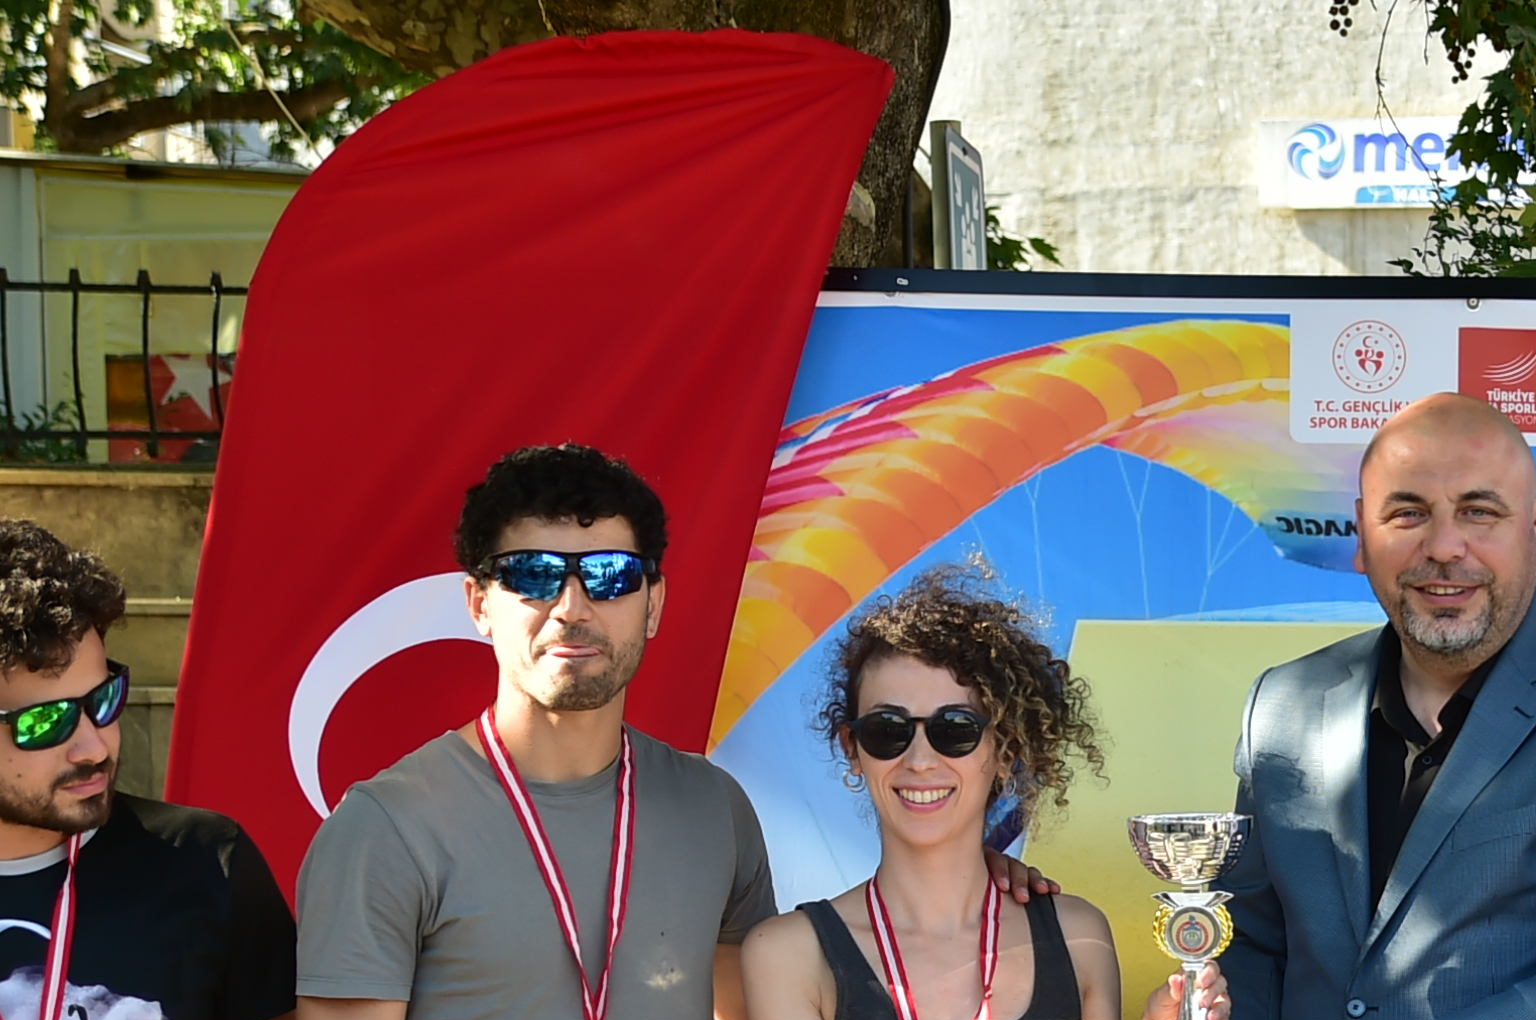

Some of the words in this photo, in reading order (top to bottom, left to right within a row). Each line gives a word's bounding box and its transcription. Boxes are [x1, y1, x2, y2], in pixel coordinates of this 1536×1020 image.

[1486, 388, 1535, 402] TÜRKİYE
[1314, 401, 1338, 412] T.C.
[1310, 417, 1347, 429] SPOR
